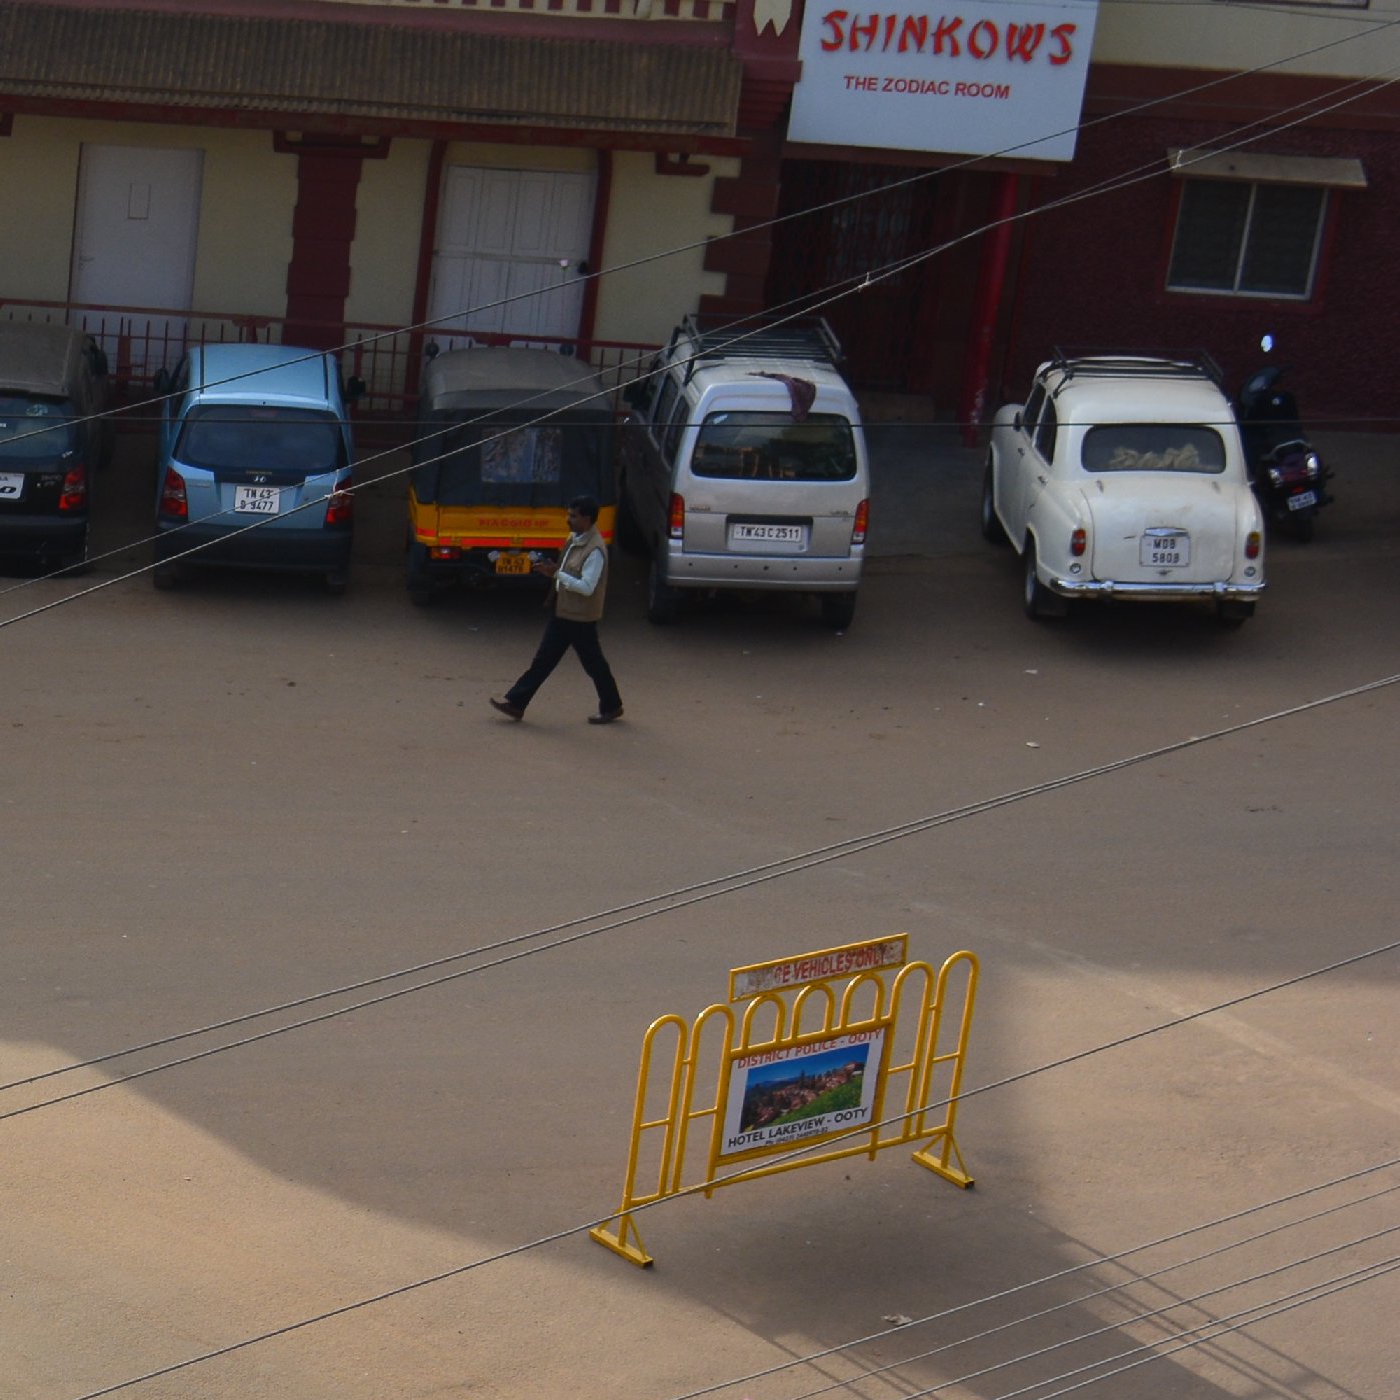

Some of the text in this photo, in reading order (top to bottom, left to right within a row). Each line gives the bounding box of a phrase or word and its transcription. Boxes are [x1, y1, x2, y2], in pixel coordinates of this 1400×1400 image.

[820, 10, 1078, 65] SHINKOWS
[844, 76, 1010, 100] THE ZODIAC ROOM
[244, 488, 257, 499] TN
[740, 526, 800, 539] TN 43 C 2511
[793, 953, 852, 981] VEHICLES
[737, 1050, 790, 1069] DISTRICT
[795, 1041, 836, 1056] POLICE
[848, 1029, 881, 1044] OOTY
[728, 1133, 767, 1148] HOTEL
[768, 1117, 825, 1138] LAKEVIEW
[834, 1108, 868, 1123] OOTY
